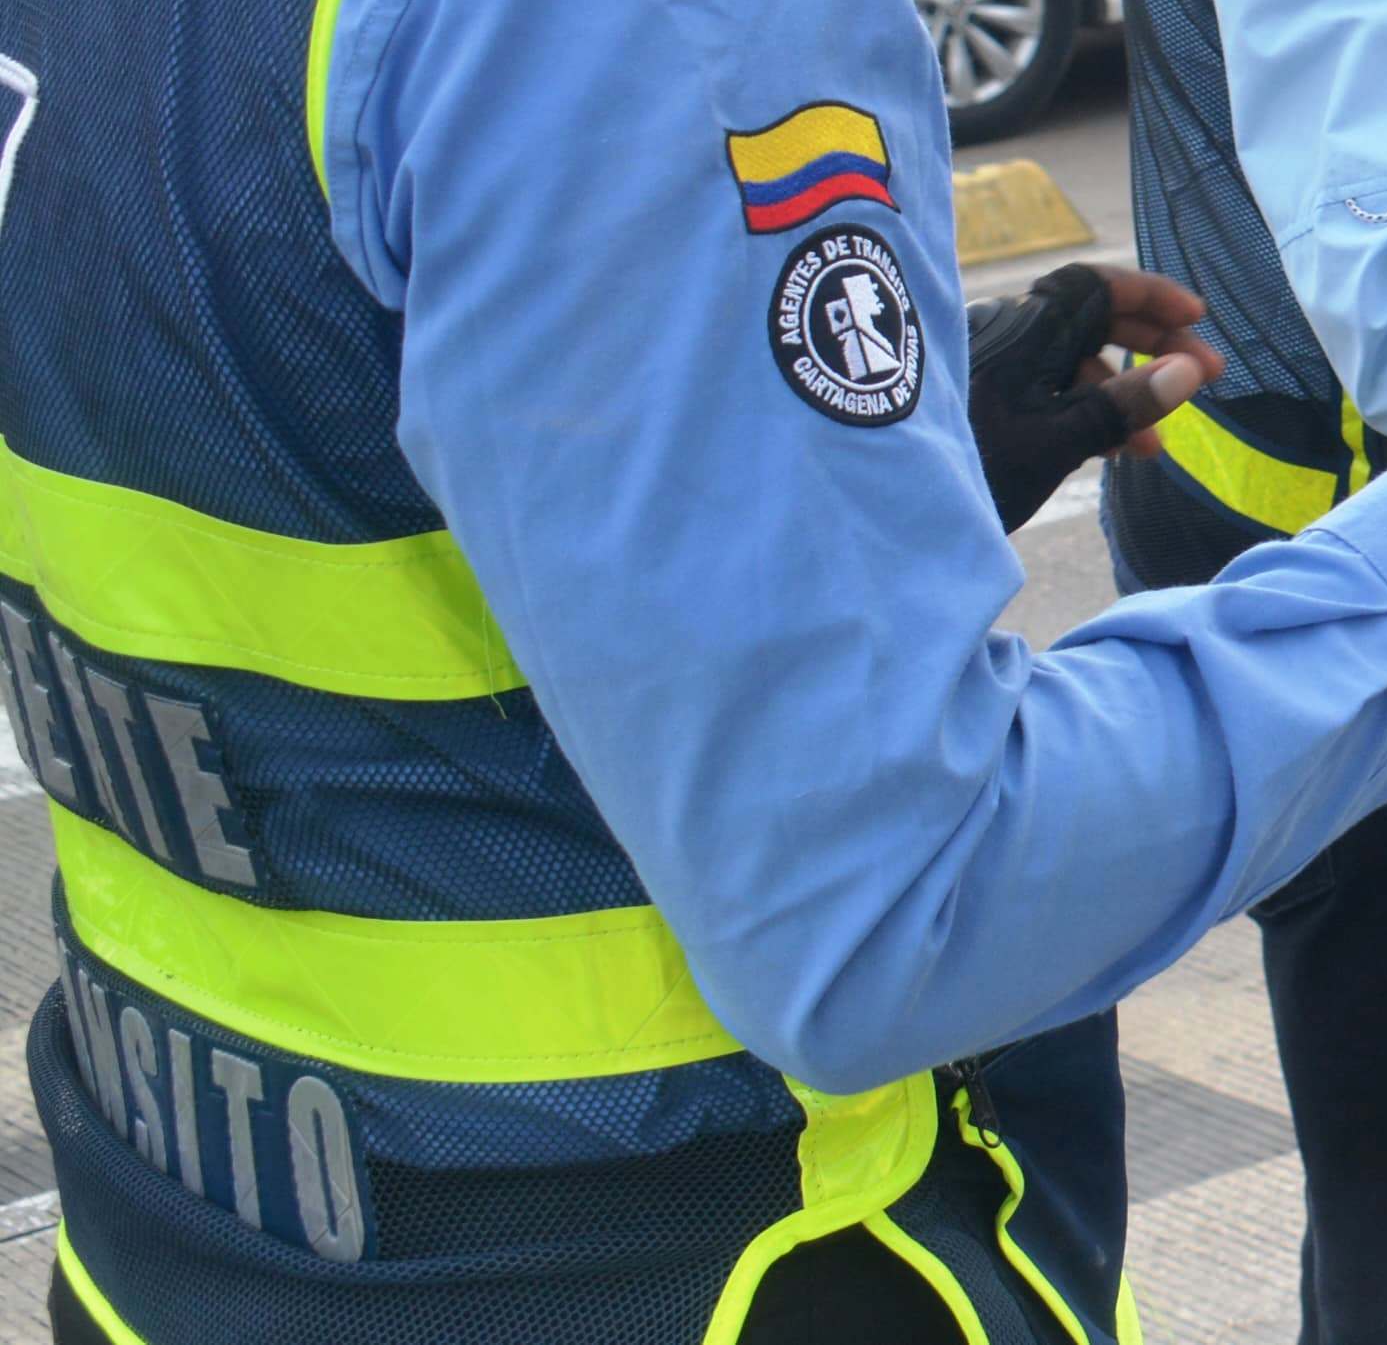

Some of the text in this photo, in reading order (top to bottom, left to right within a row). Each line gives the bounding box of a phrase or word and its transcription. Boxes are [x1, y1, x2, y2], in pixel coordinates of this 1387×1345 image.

[778, 234, 911, 346] AGENTES DE TRANSITO
[792, 355, 894, 416] CARTAGENA
[891, 380, 912, 408] DE
